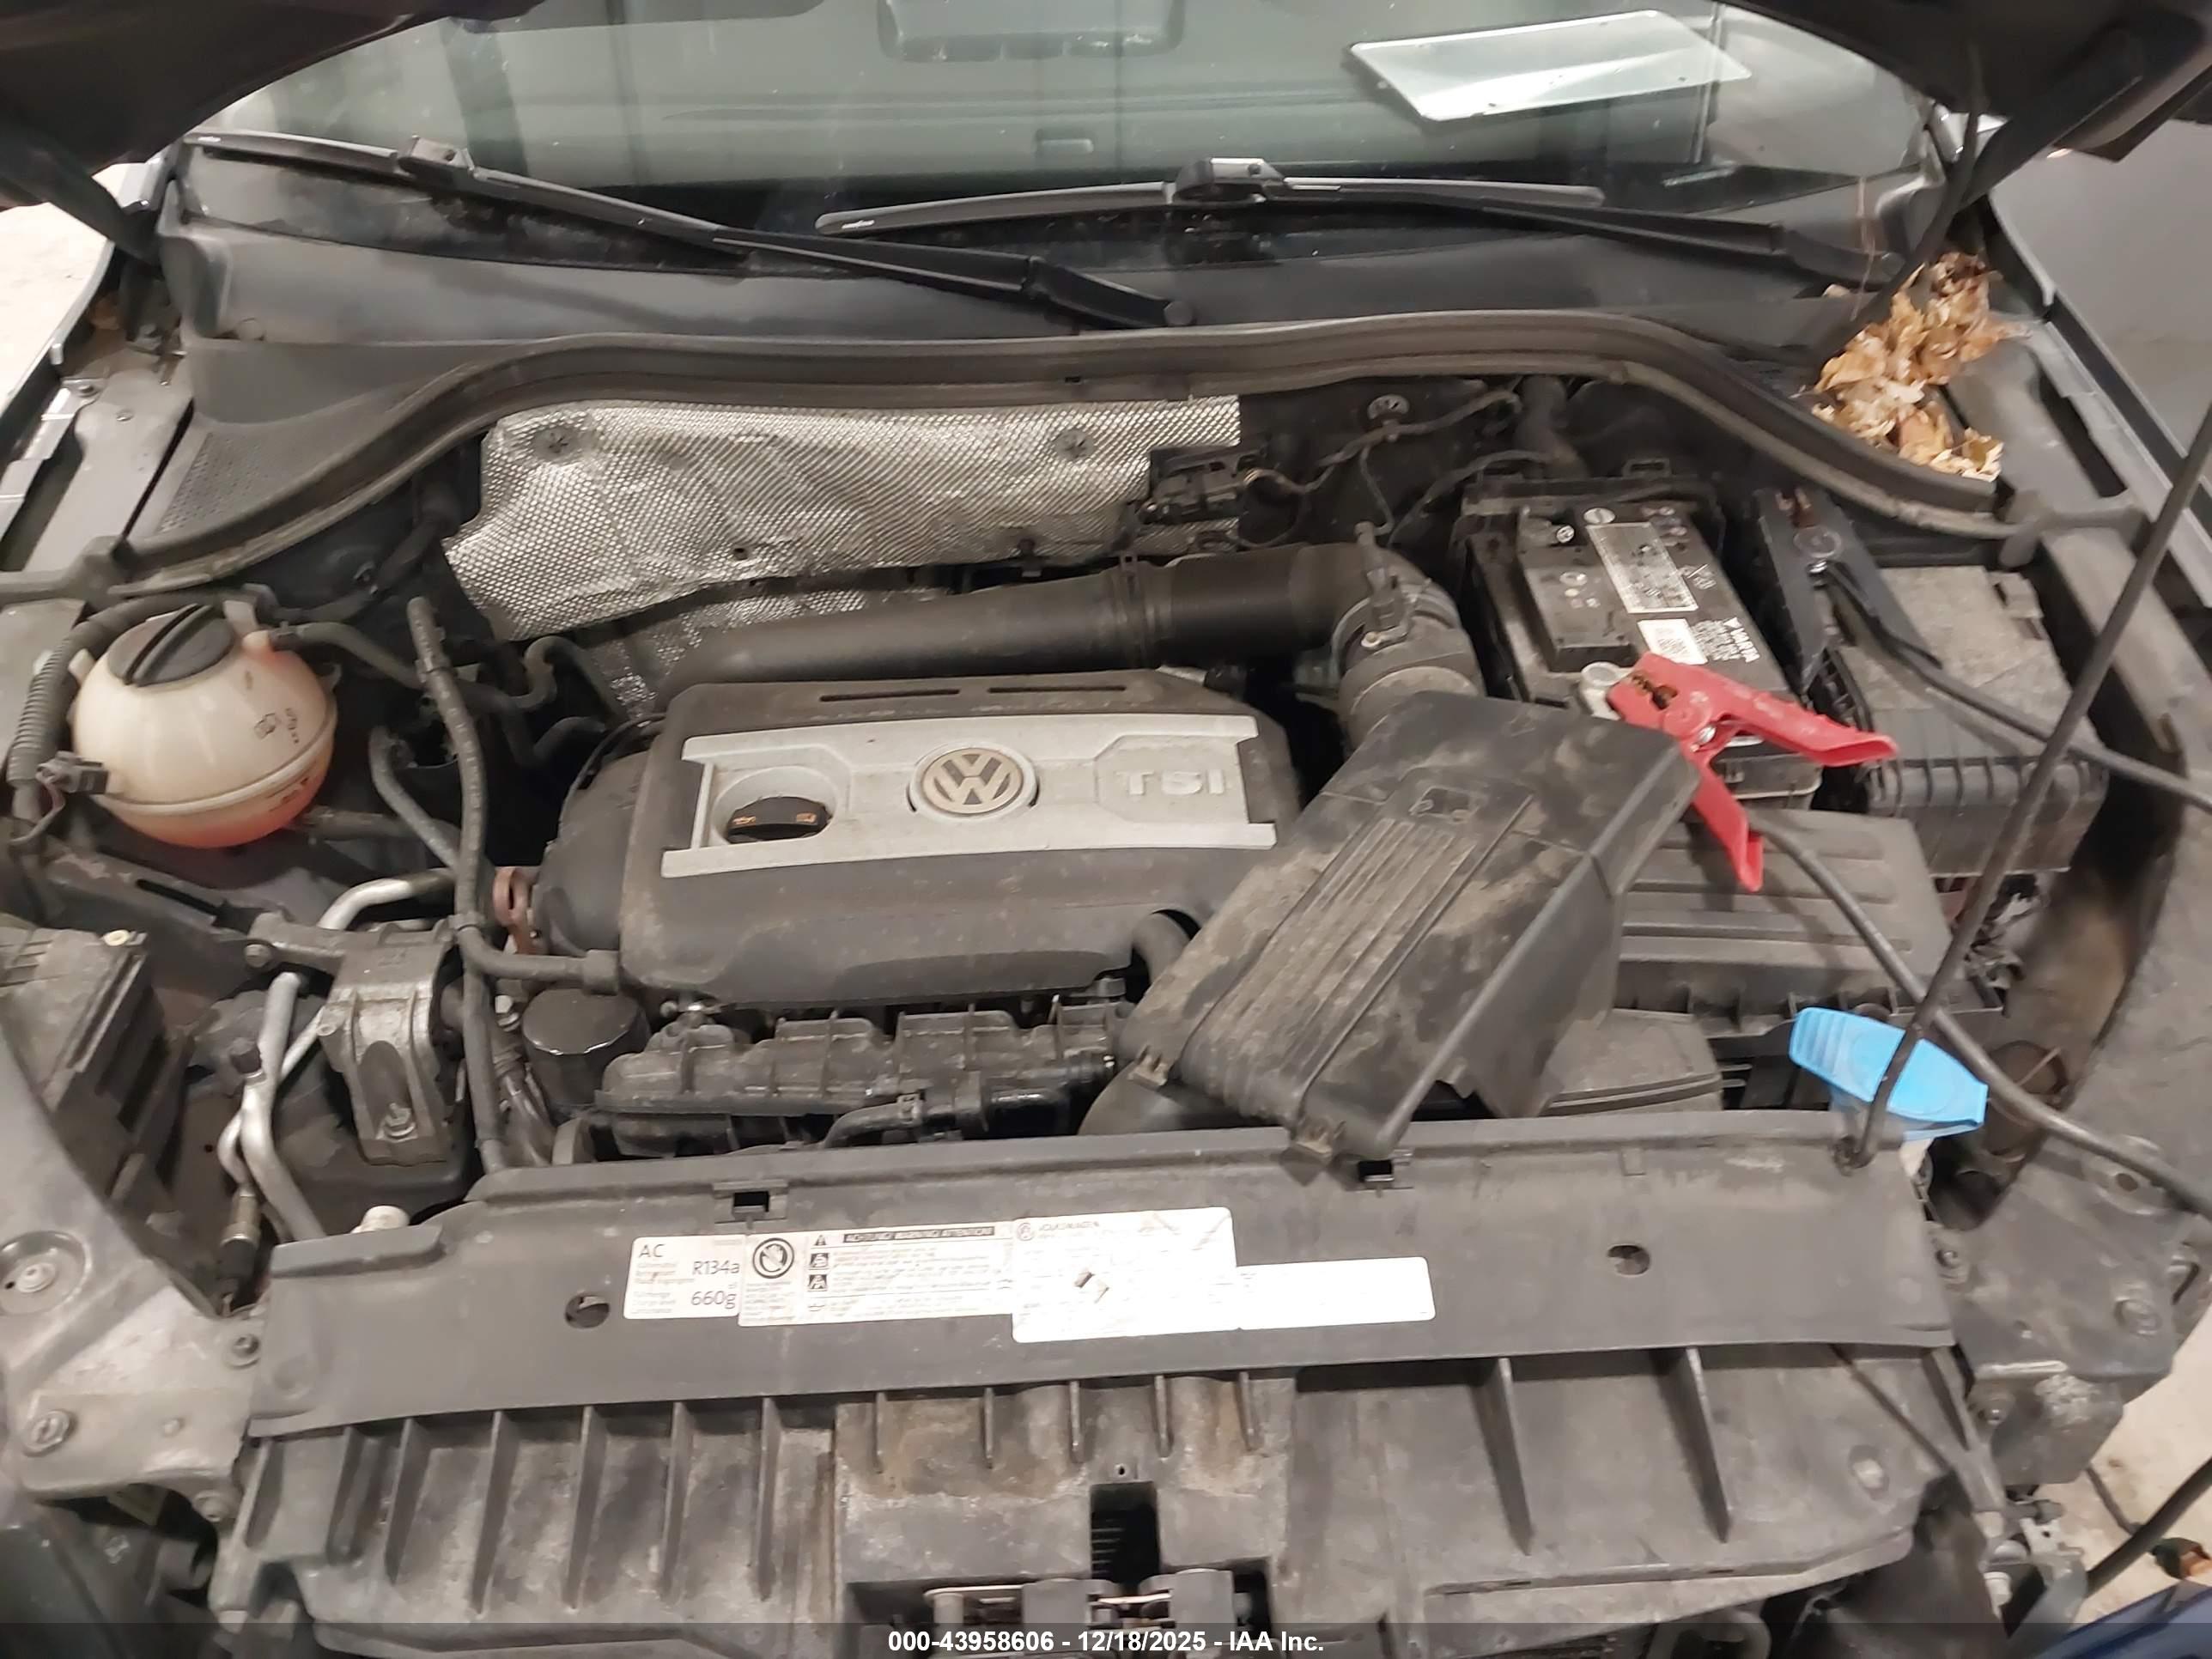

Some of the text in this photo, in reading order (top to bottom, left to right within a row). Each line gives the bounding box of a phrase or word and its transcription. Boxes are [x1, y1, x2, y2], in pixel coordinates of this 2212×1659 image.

[1115, 770, 1224, 794] TSI
[639, 1243, 665, 1258] AC
[692, 1260, 740, 1275] R134a
[690, 1290, 737, 1310] 660g
